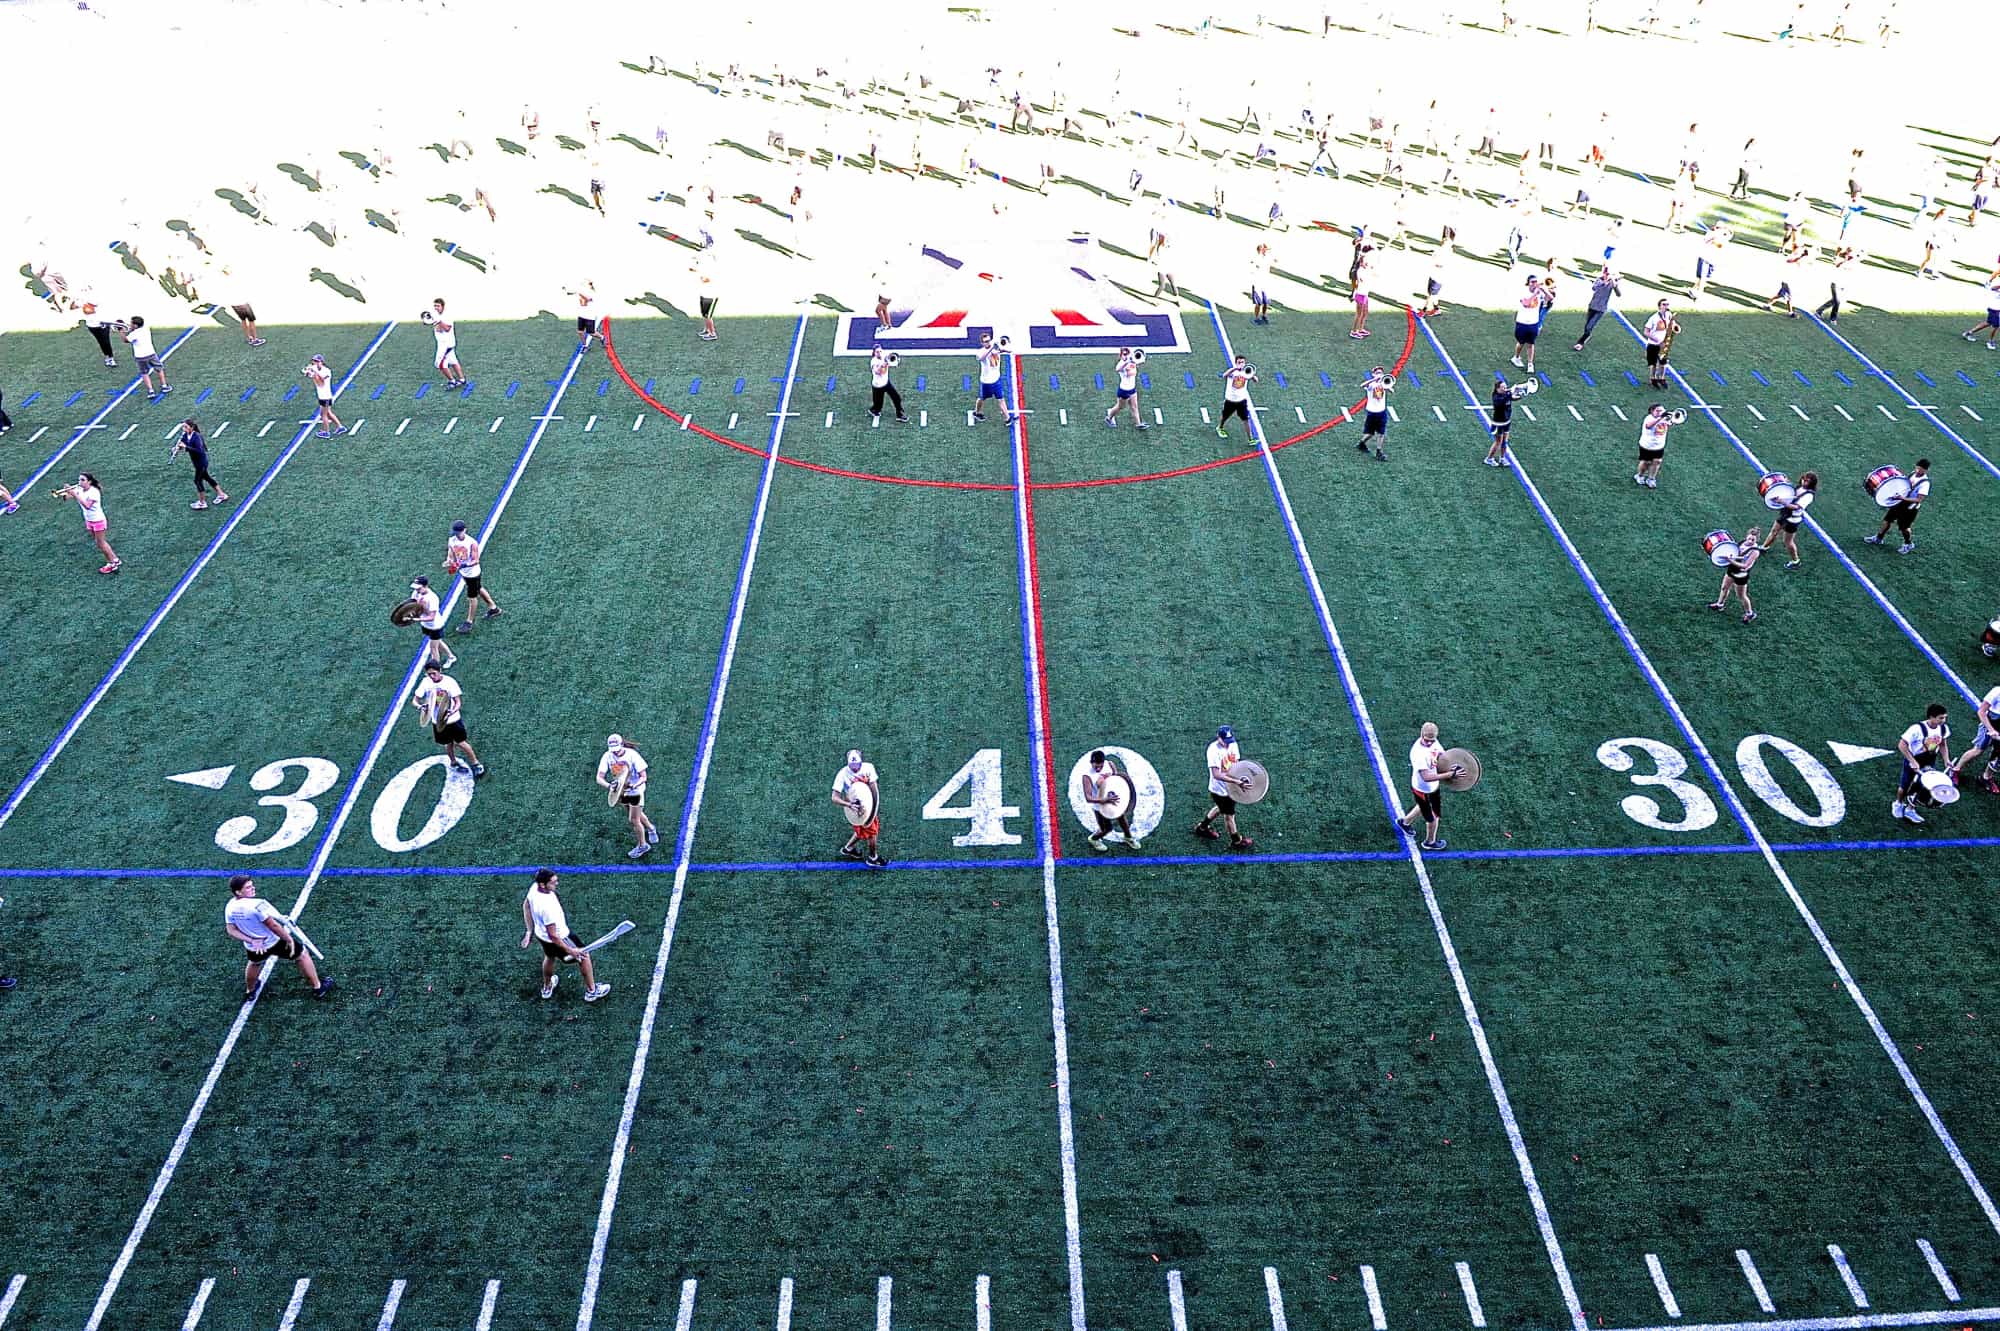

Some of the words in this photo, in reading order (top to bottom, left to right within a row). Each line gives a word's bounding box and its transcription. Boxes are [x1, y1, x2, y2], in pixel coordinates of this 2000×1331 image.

[215, 756, 475, 854] 30
[922, 747, 1165, 847] 40
[1597, 734, 1846, 831] 30
